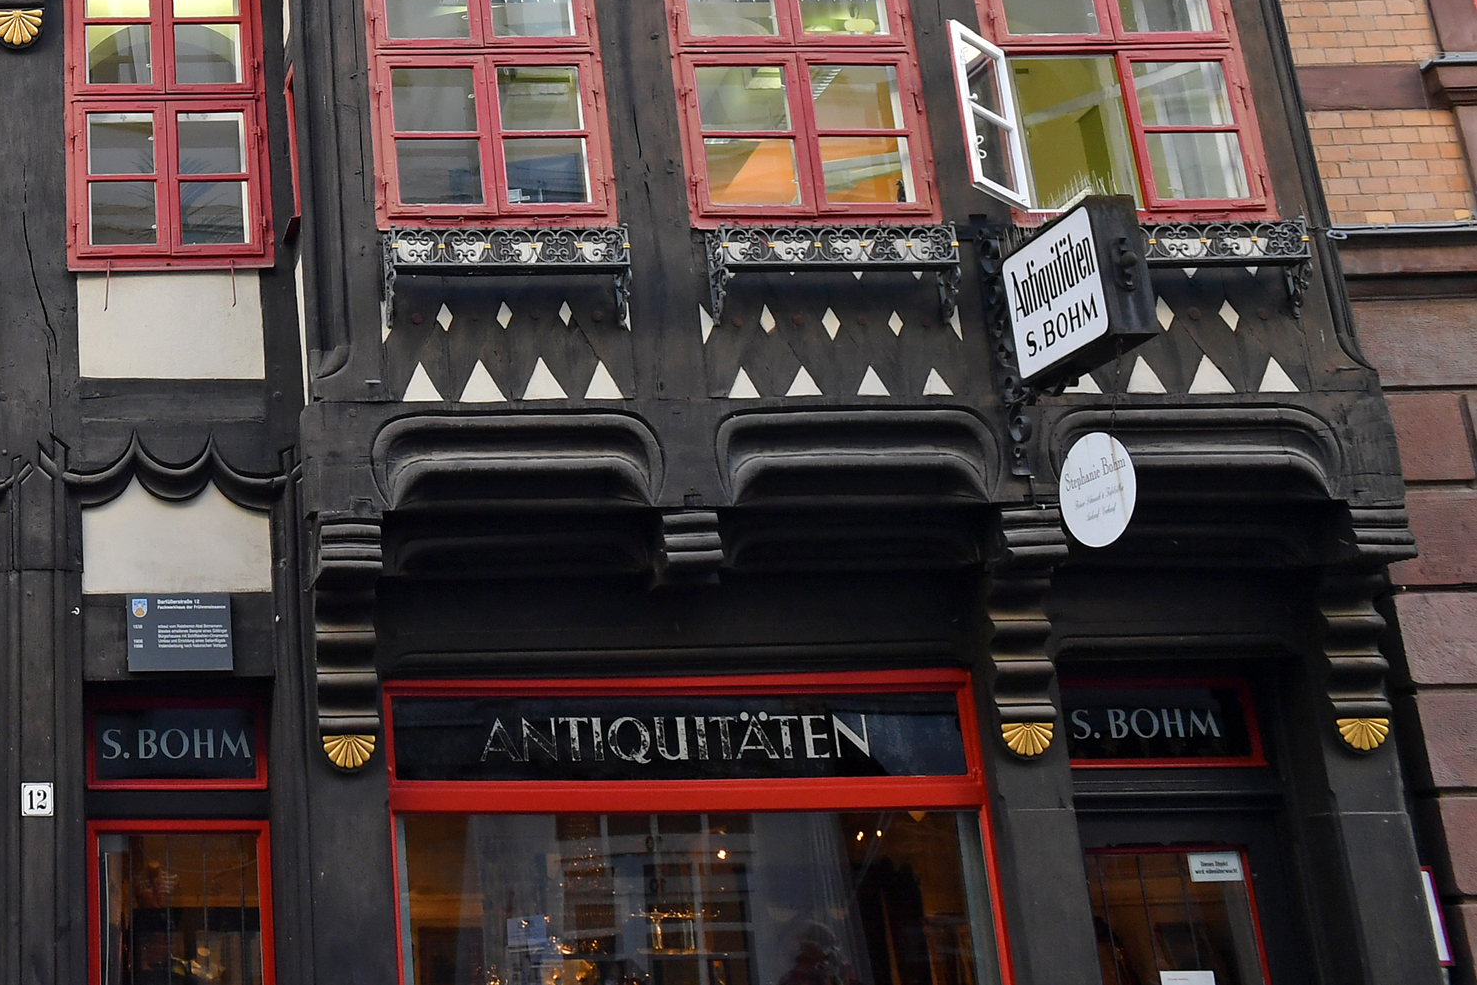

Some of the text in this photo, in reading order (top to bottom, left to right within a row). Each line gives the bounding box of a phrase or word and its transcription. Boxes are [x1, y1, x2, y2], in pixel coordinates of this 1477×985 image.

[1010, 233, 1097, 323] Antiquitäten
[1064, 453, 1126, 492] Stephanie Bohm
[480, 710, 871, 765] ANTIQUITÄTEN
[1108, 708, 1221, 739] BOHM
[138, 727, 251, 760] BOHM
[27, 789, 48, 811] 12
